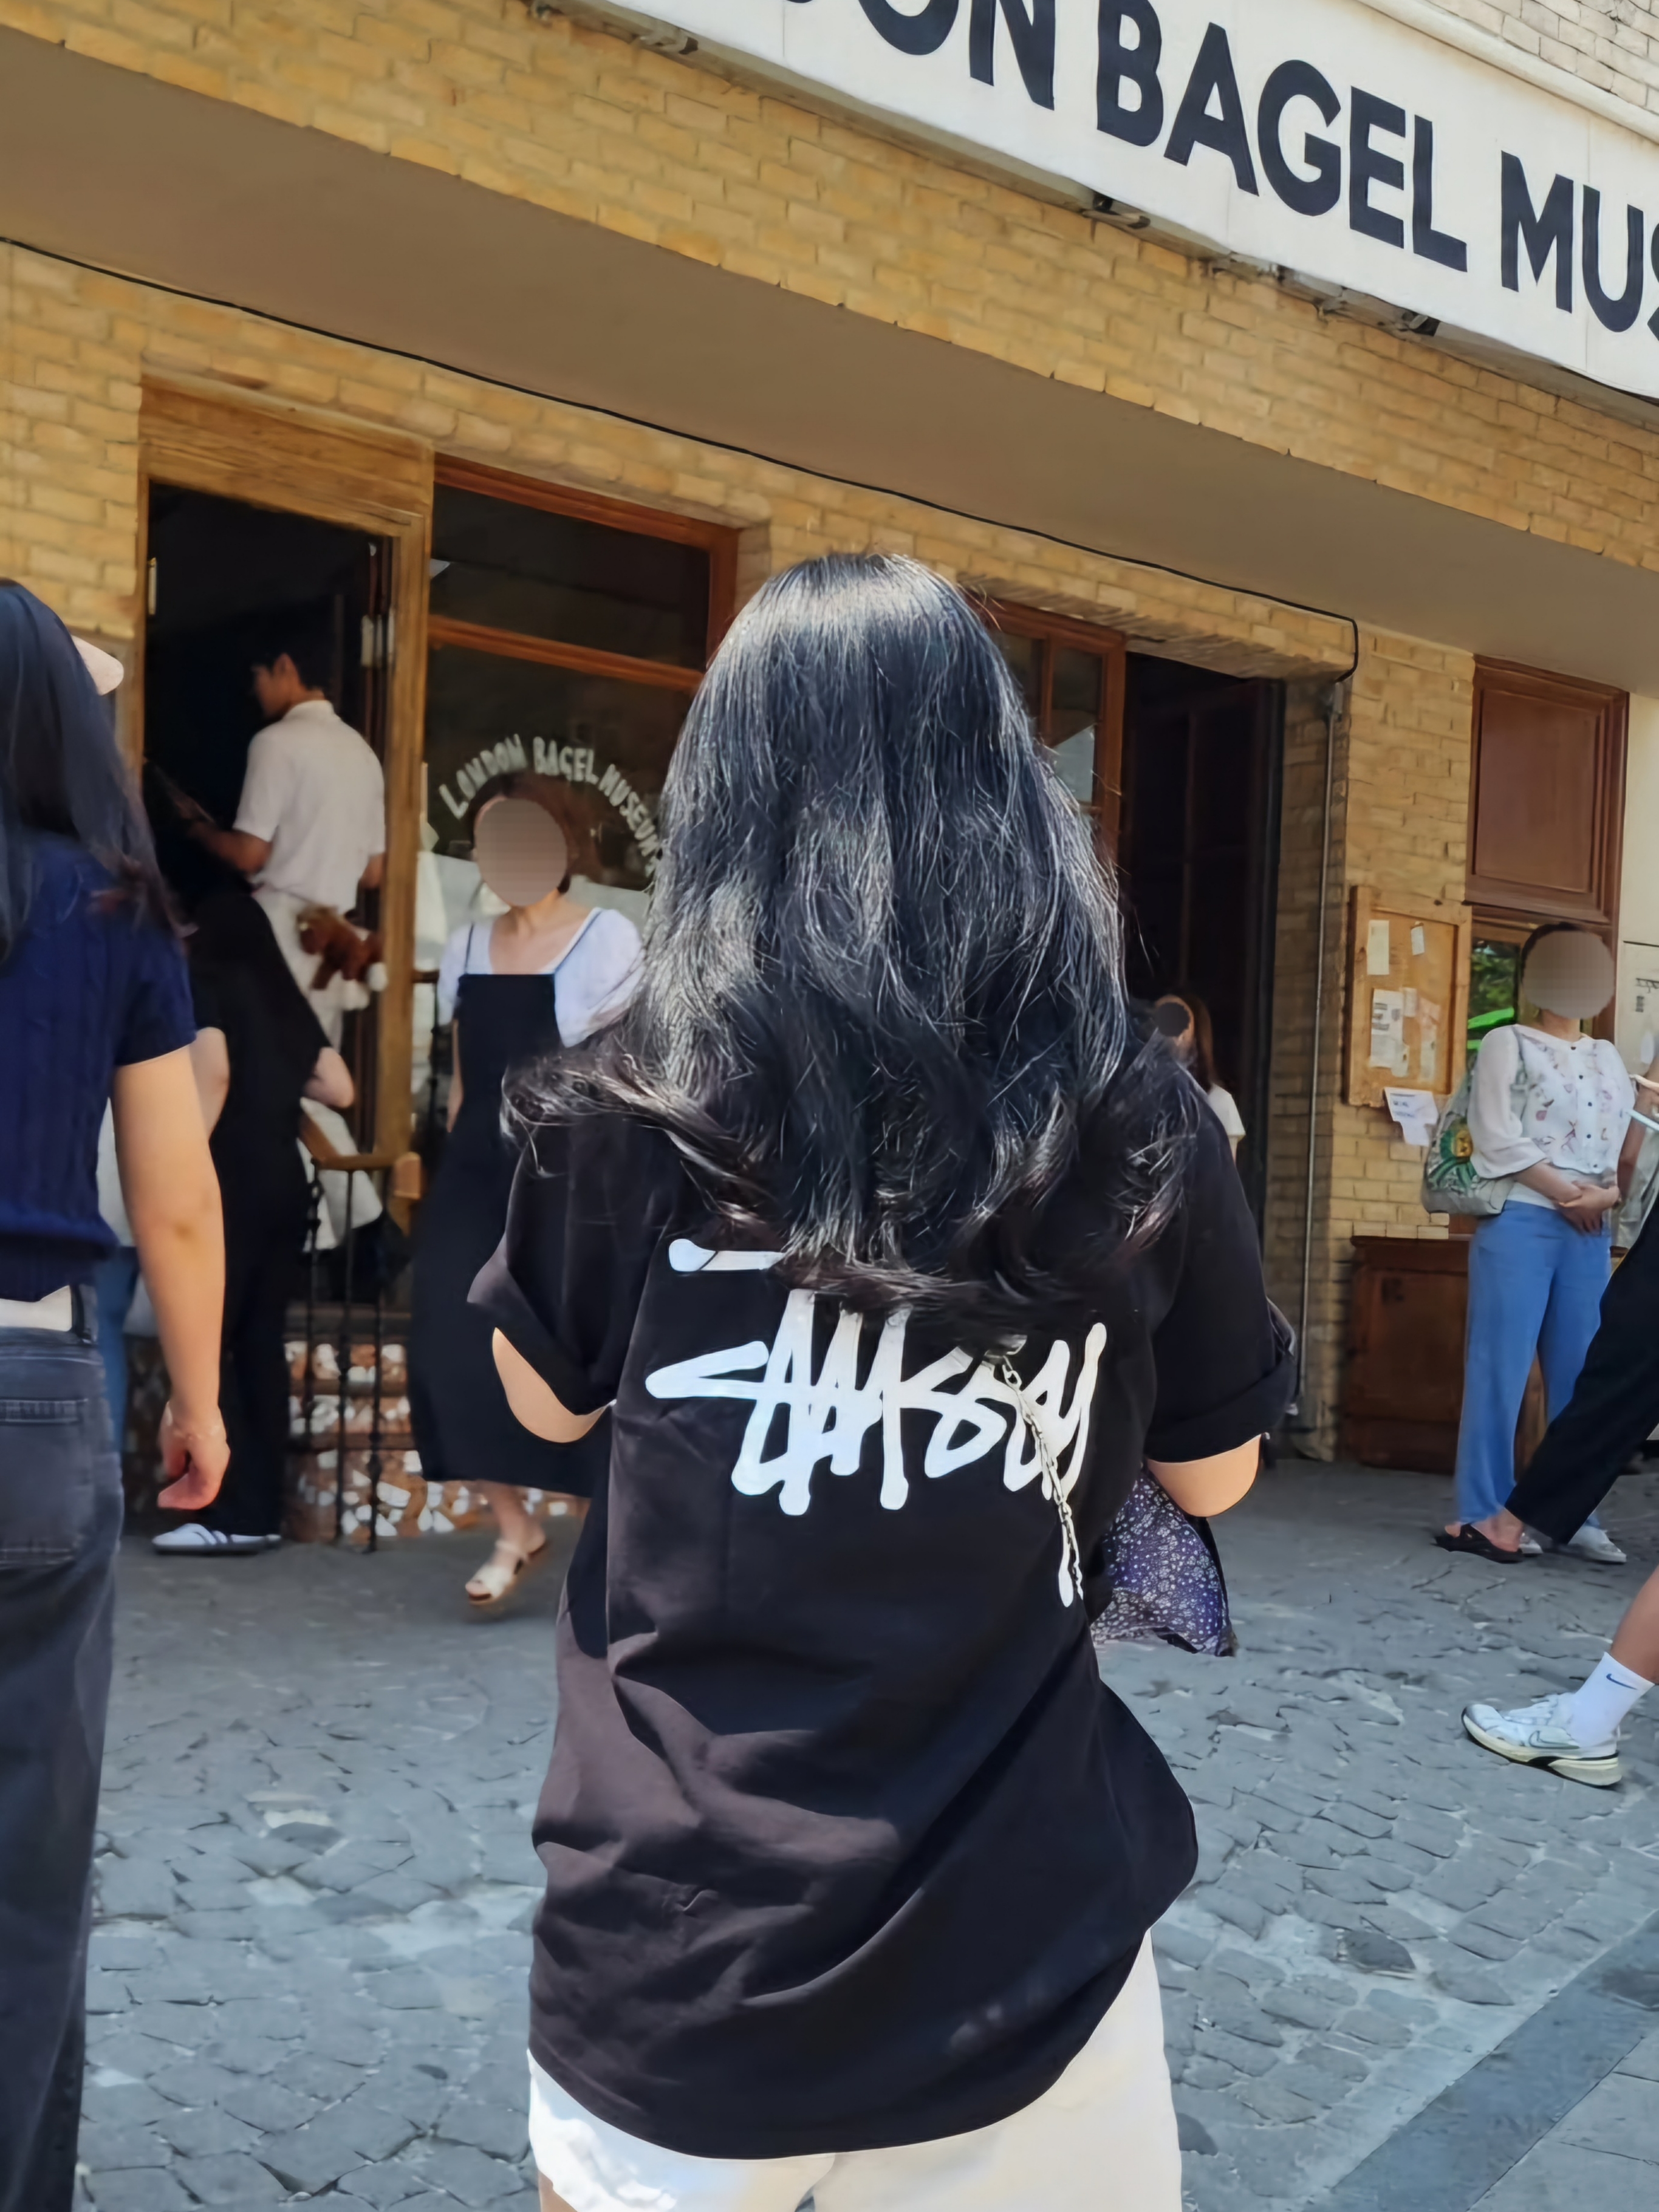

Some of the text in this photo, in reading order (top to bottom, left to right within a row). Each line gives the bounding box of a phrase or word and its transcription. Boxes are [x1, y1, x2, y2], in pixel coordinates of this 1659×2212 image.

[1096, 0, 1468, 273] BAGEL
[1499, 149, 1659, 343] MU
[439, 733, 528, 819] LONDON
[532, 736, 600, 785] BAGEL
